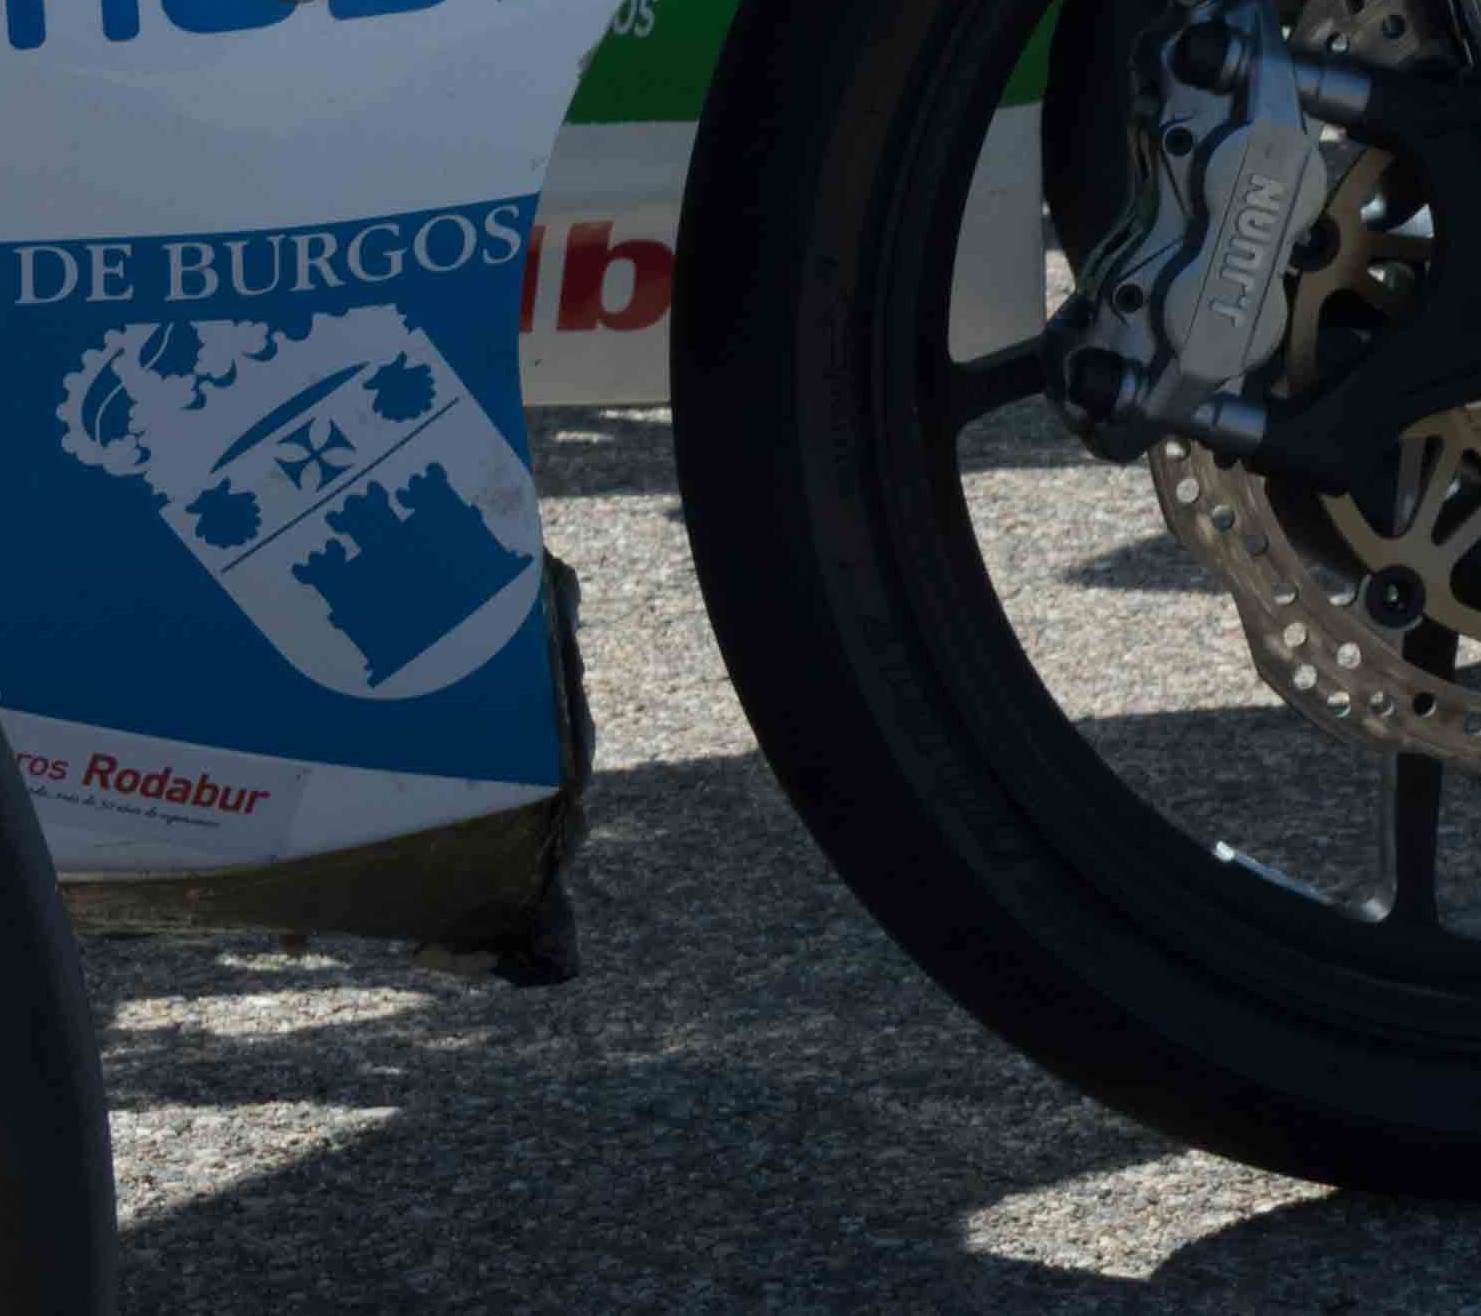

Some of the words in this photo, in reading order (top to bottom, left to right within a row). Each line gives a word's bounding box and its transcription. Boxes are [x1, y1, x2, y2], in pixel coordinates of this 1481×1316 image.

[13, 240, 133, 307] DE
[163, 203, 524, 304] BURGOS
[82, 752, 272, 815] Rodabur
